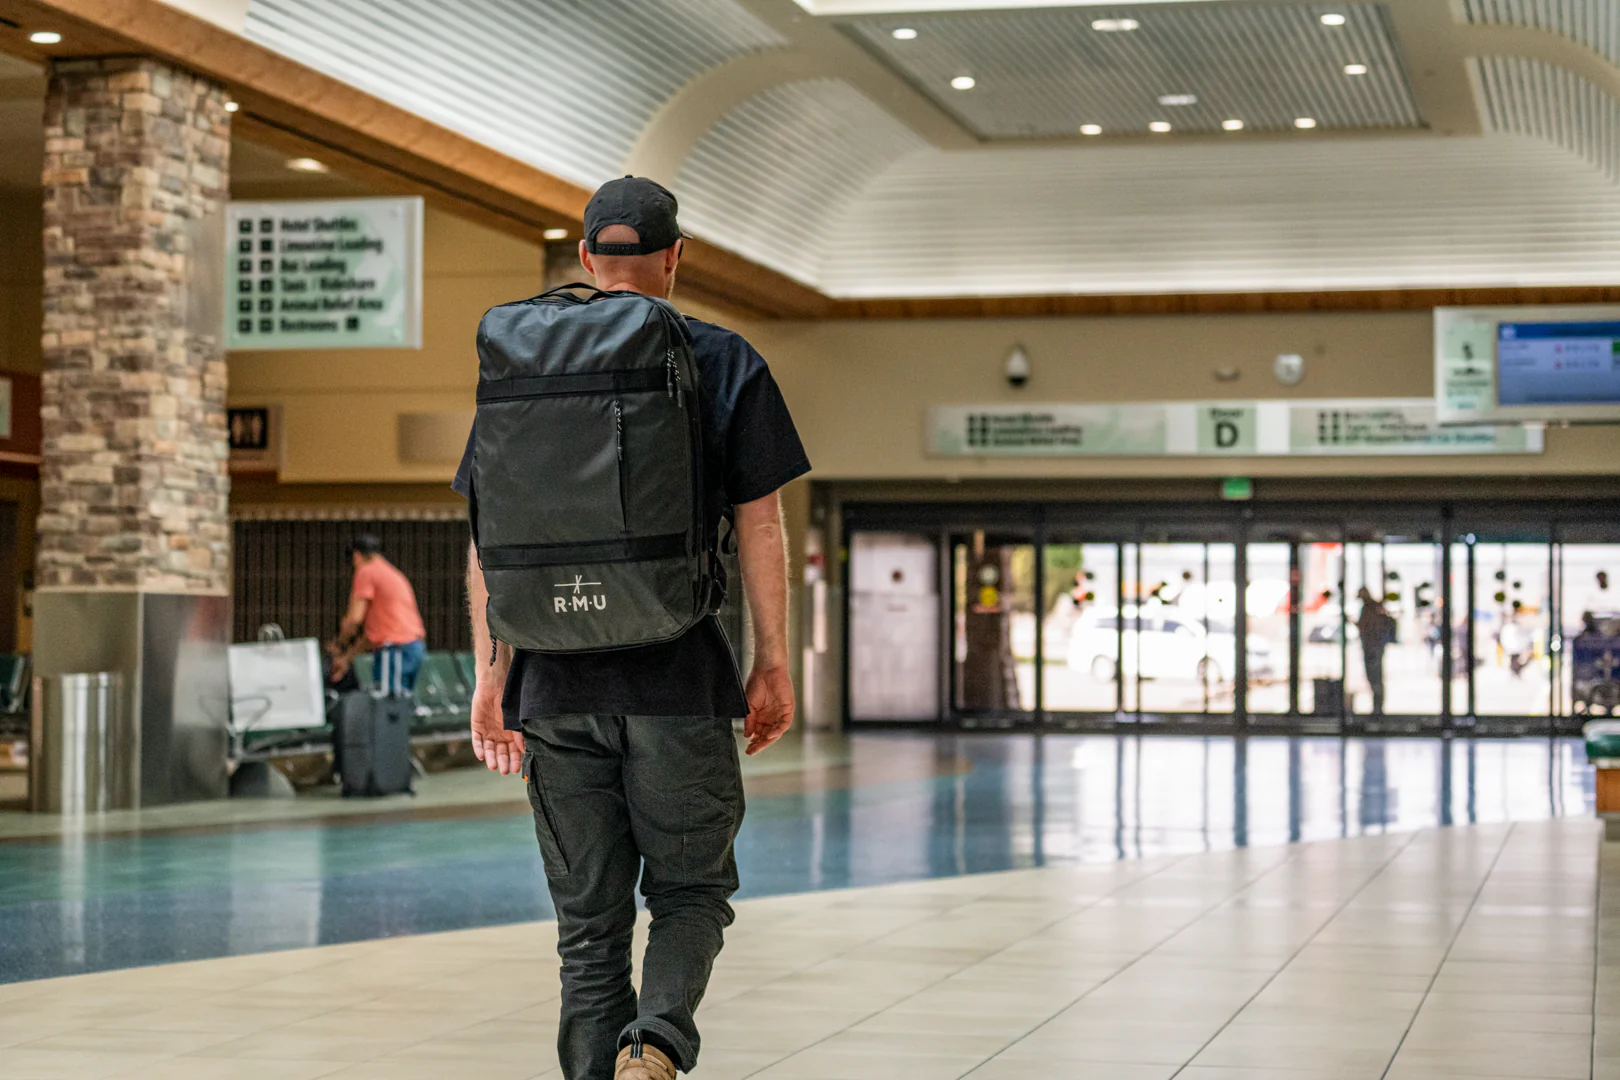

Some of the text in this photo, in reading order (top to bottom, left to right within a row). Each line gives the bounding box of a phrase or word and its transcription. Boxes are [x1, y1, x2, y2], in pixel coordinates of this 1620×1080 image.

[281, 217, 309, 232] Hotel
[340, 236, 383, 254] Loading
[304, 257, 347, 275] Loading
[281, 298, 319, 312] Animal
[1215, 421, 1239, 448] D
